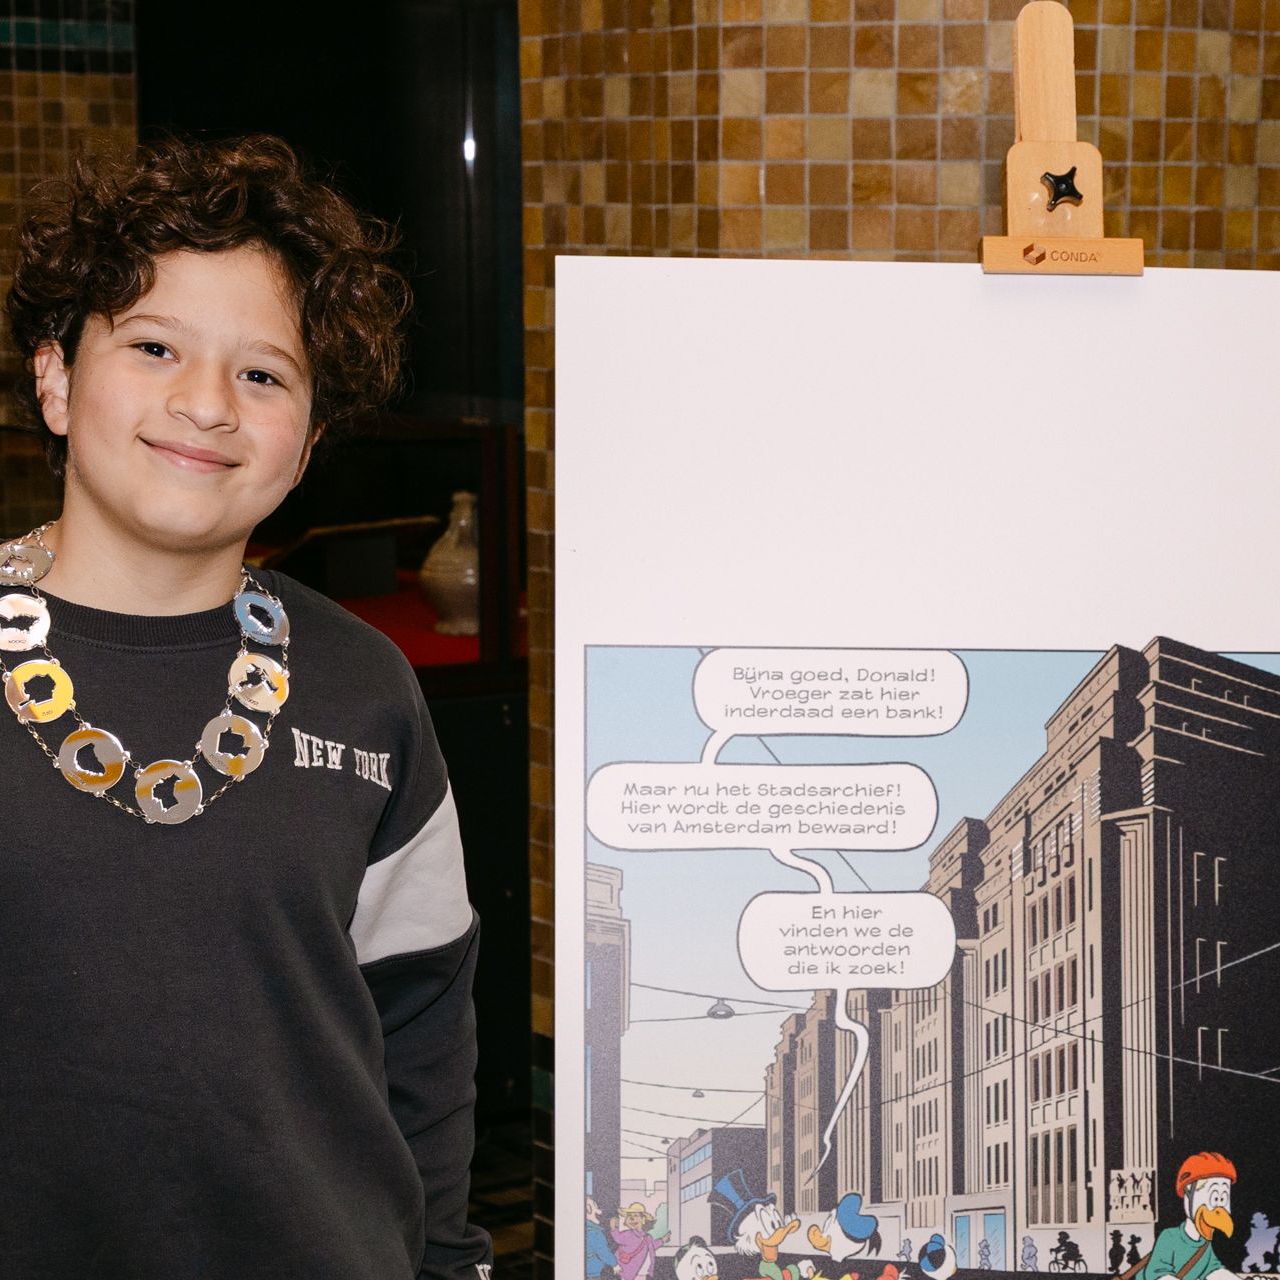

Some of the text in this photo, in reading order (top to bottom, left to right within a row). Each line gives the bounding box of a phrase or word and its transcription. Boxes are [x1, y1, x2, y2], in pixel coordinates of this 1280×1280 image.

[1050, 250, 1098, 263] CONDA
[790, 668, 849, 685] goed,
[857, 668, 935, 682] Donald!
[749, 687, 921, 704] Vroeger zat hier
[724, 705, 943, 719] inderdaad een bank!
[291, 727, 392, 791] NEW YORK
[623, 783, 901, 797] Maar nu het Stadsarchief!
[621, 801, 906, 818] Hier wordt de geschiedenis
[627, 820, 897, 835] van Amsterdam bewaard!
[811, 905, 883, 919] En hier
[779, 924, 914, 937] vinden we de
[784, 943, 911, 957] antwoorden
[787, 961, 905, 975] die ik zoek!
